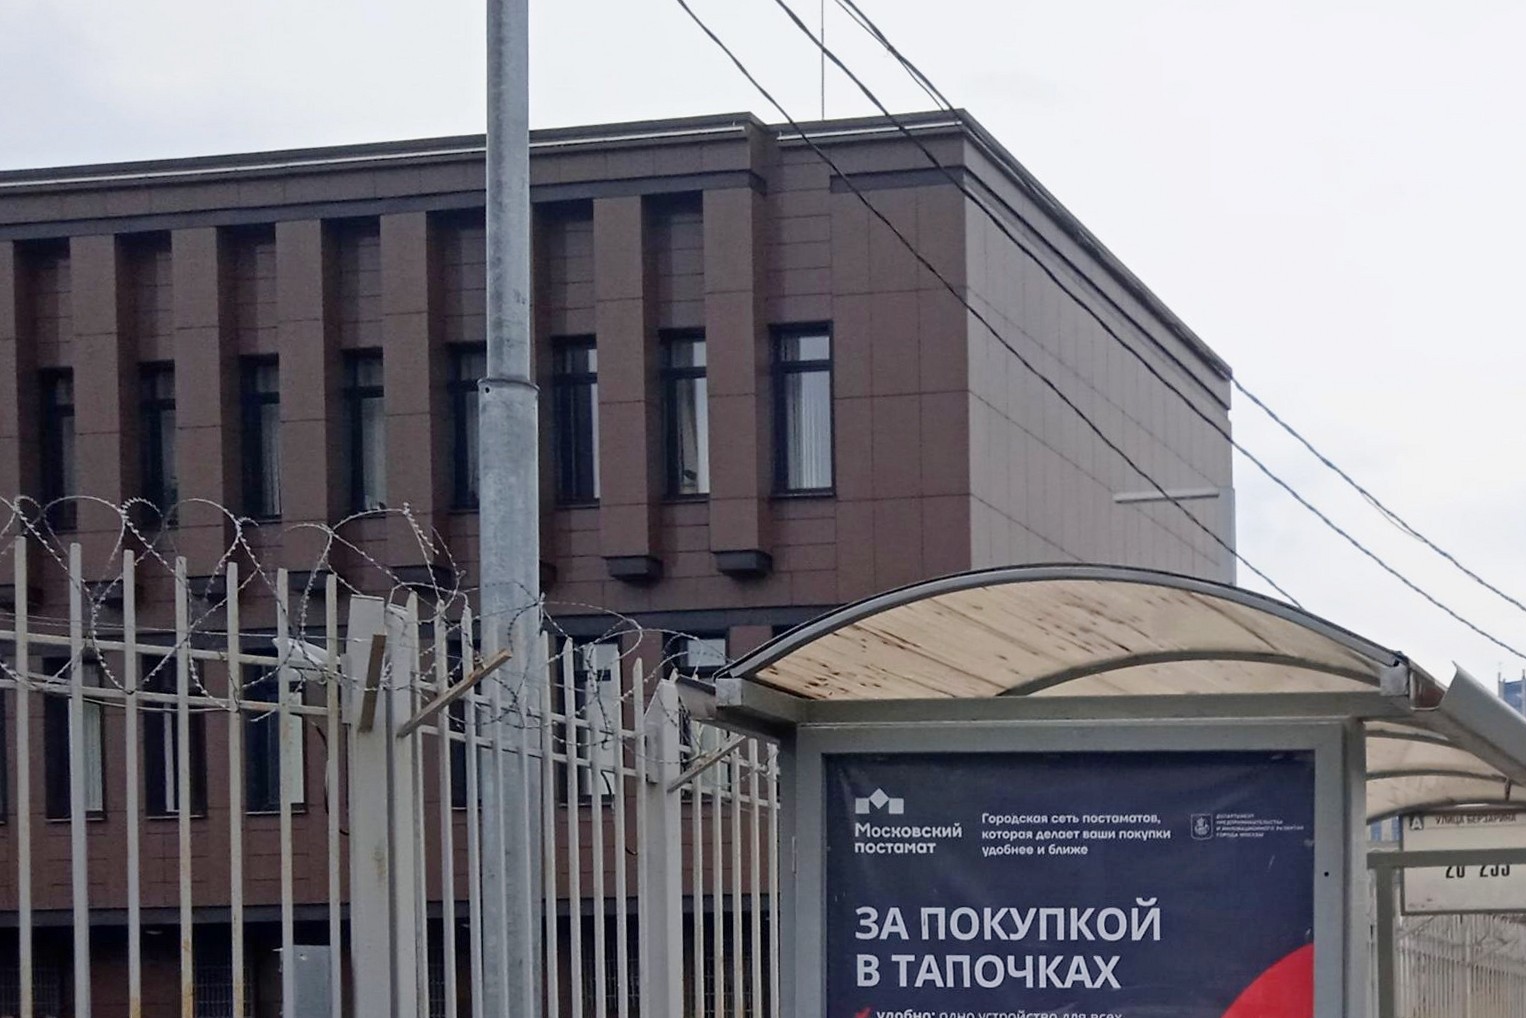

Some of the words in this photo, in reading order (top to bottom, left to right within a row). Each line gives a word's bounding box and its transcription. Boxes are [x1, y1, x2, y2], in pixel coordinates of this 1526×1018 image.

[981, 812, 1048, 826] Городская
[1050, 814, 1080, 824] сеть
[1082, 813, 1162, 826] постаматов,
[854, 822, 963, 838] Московский
[981, 830, 1033, 842] которая
[1035, 829, 1080, 842] делает
[1082, 830, 1116, 839] ваши
[1118, 829, 1171, 842] покупки
[854, 842, 937, 854] постамат
[981, 843, 1034, 858] удобнее
[1037, 846, 1046, 855] и
[1048, 843, 1089, 855] ближе
[855, 906, 910, 940] ЗА
[920, 897, 1161, 942] ПОКУПКОЙ
[856, 953, 881, 987] В
[891, 954, 1122, 989] ТАПОЧКАХ
